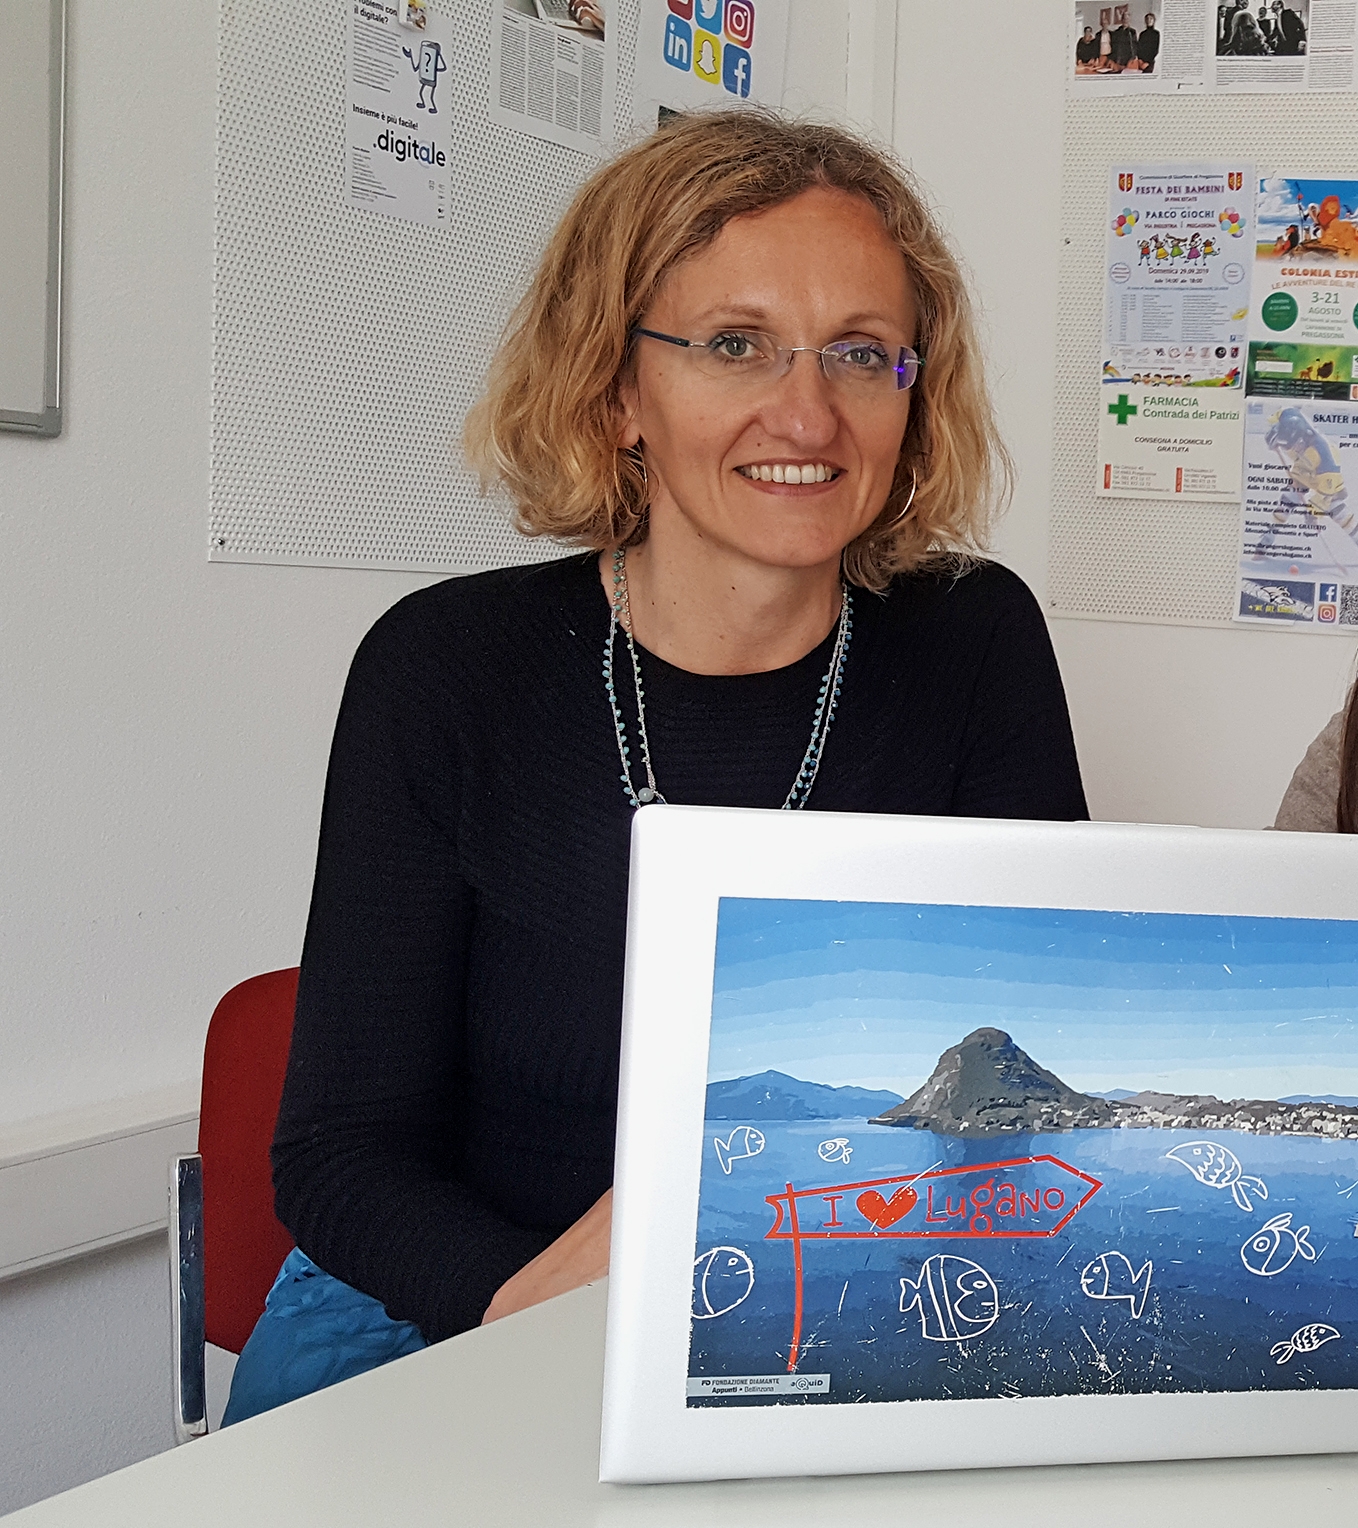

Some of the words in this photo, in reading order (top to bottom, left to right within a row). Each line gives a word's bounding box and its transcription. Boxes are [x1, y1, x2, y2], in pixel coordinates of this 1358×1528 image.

[360, 8, 388, 24] digitale?
[352, 103, 379, 119] Insieme
[381, 111, 386, 120] è
[386, 114, 397, 124] più
[398, 117, 418, 131] facile!
[373, 129, 446, 167] .digitale
[1135, 186, 1163, 195] FESTA
[1166, 186, 1182, 194] DEI
[1185, 184, 1225, 193] BAMBINI
[1145, 211, 1177, 219] PARCO
[1180, 210, 1215, 219] GIOCHI
[1148, 267, 1179, 275] Domenica
[1280, 267, 1332, 278] COLONIA
[1271, 282, 1281, 290] LE
[1283, 280, 1329, 288] AVVENTURE
[1311, 291, 1340, 304] 3-21
[1308, 307, 1342, 316] AGOSTO
[1301, 331, 1345, 339] PREGASSONA
[1143, 396, 1199, 407] FARMACIA
[1142, 408, 1190, 418] Contrada
[1191, 410, 1208, 419] dei
[1209, 410, 1240, 420] Patrizi
[1313, 413, 1349, 424] SKATER
[1266, 477, 1294, 485] SABATO
[822, 1195, 844, 1228] I
[924, 1178, 1065, 1233] Lugano
